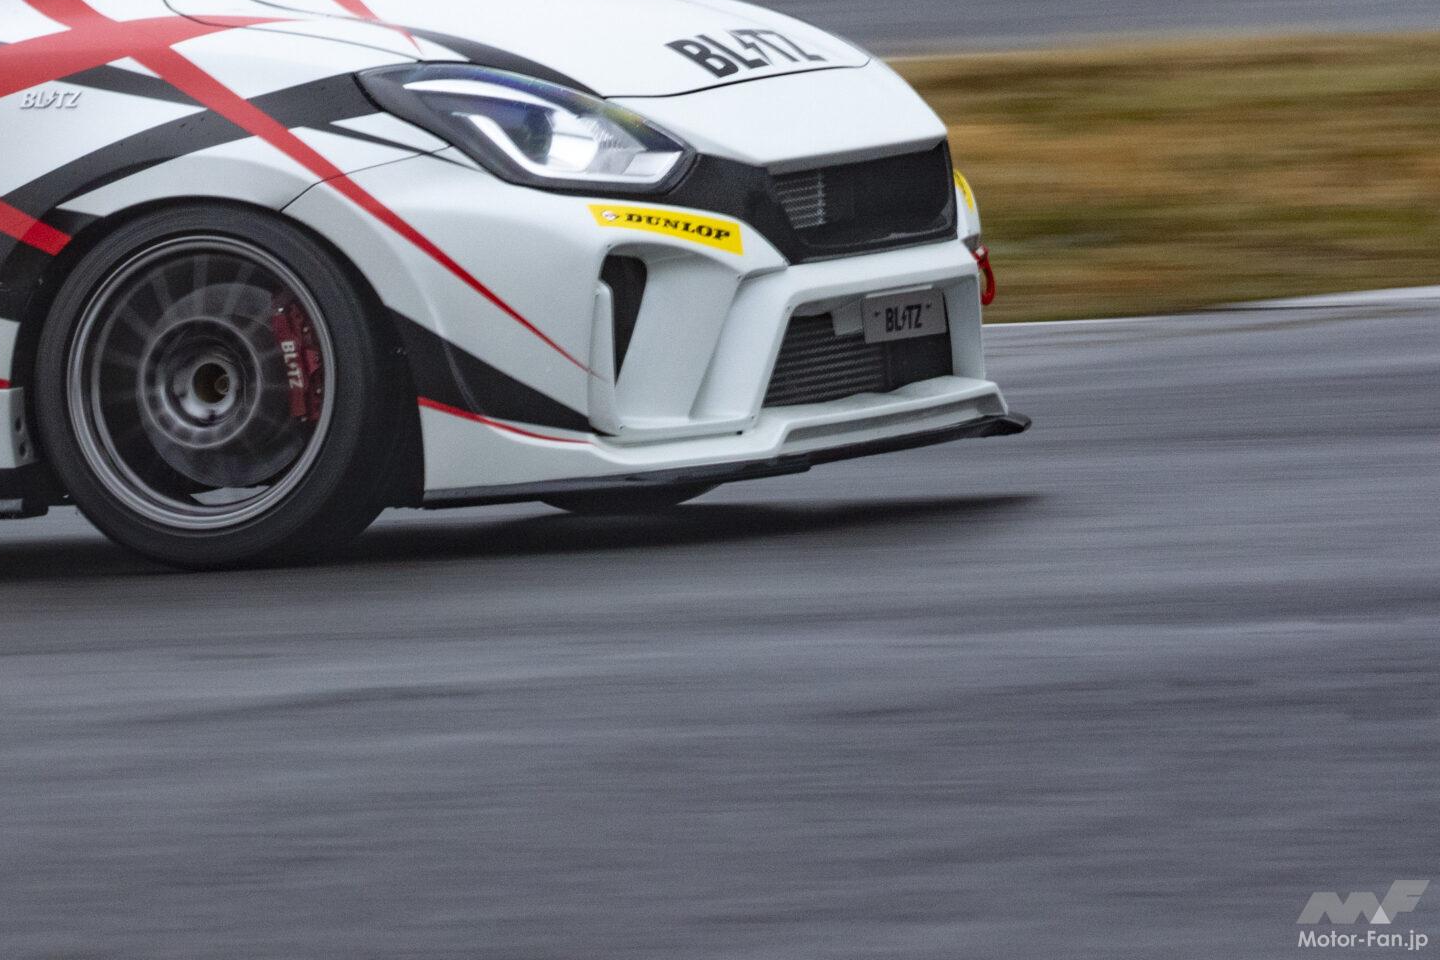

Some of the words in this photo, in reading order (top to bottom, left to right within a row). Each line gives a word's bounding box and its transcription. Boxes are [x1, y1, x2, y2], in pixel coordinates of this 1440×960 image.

[663, 28, 828, 78] BLITZ
[625, 213, 731, 240] DUNLOP
[884, 303, 923, 333] BLITZ
